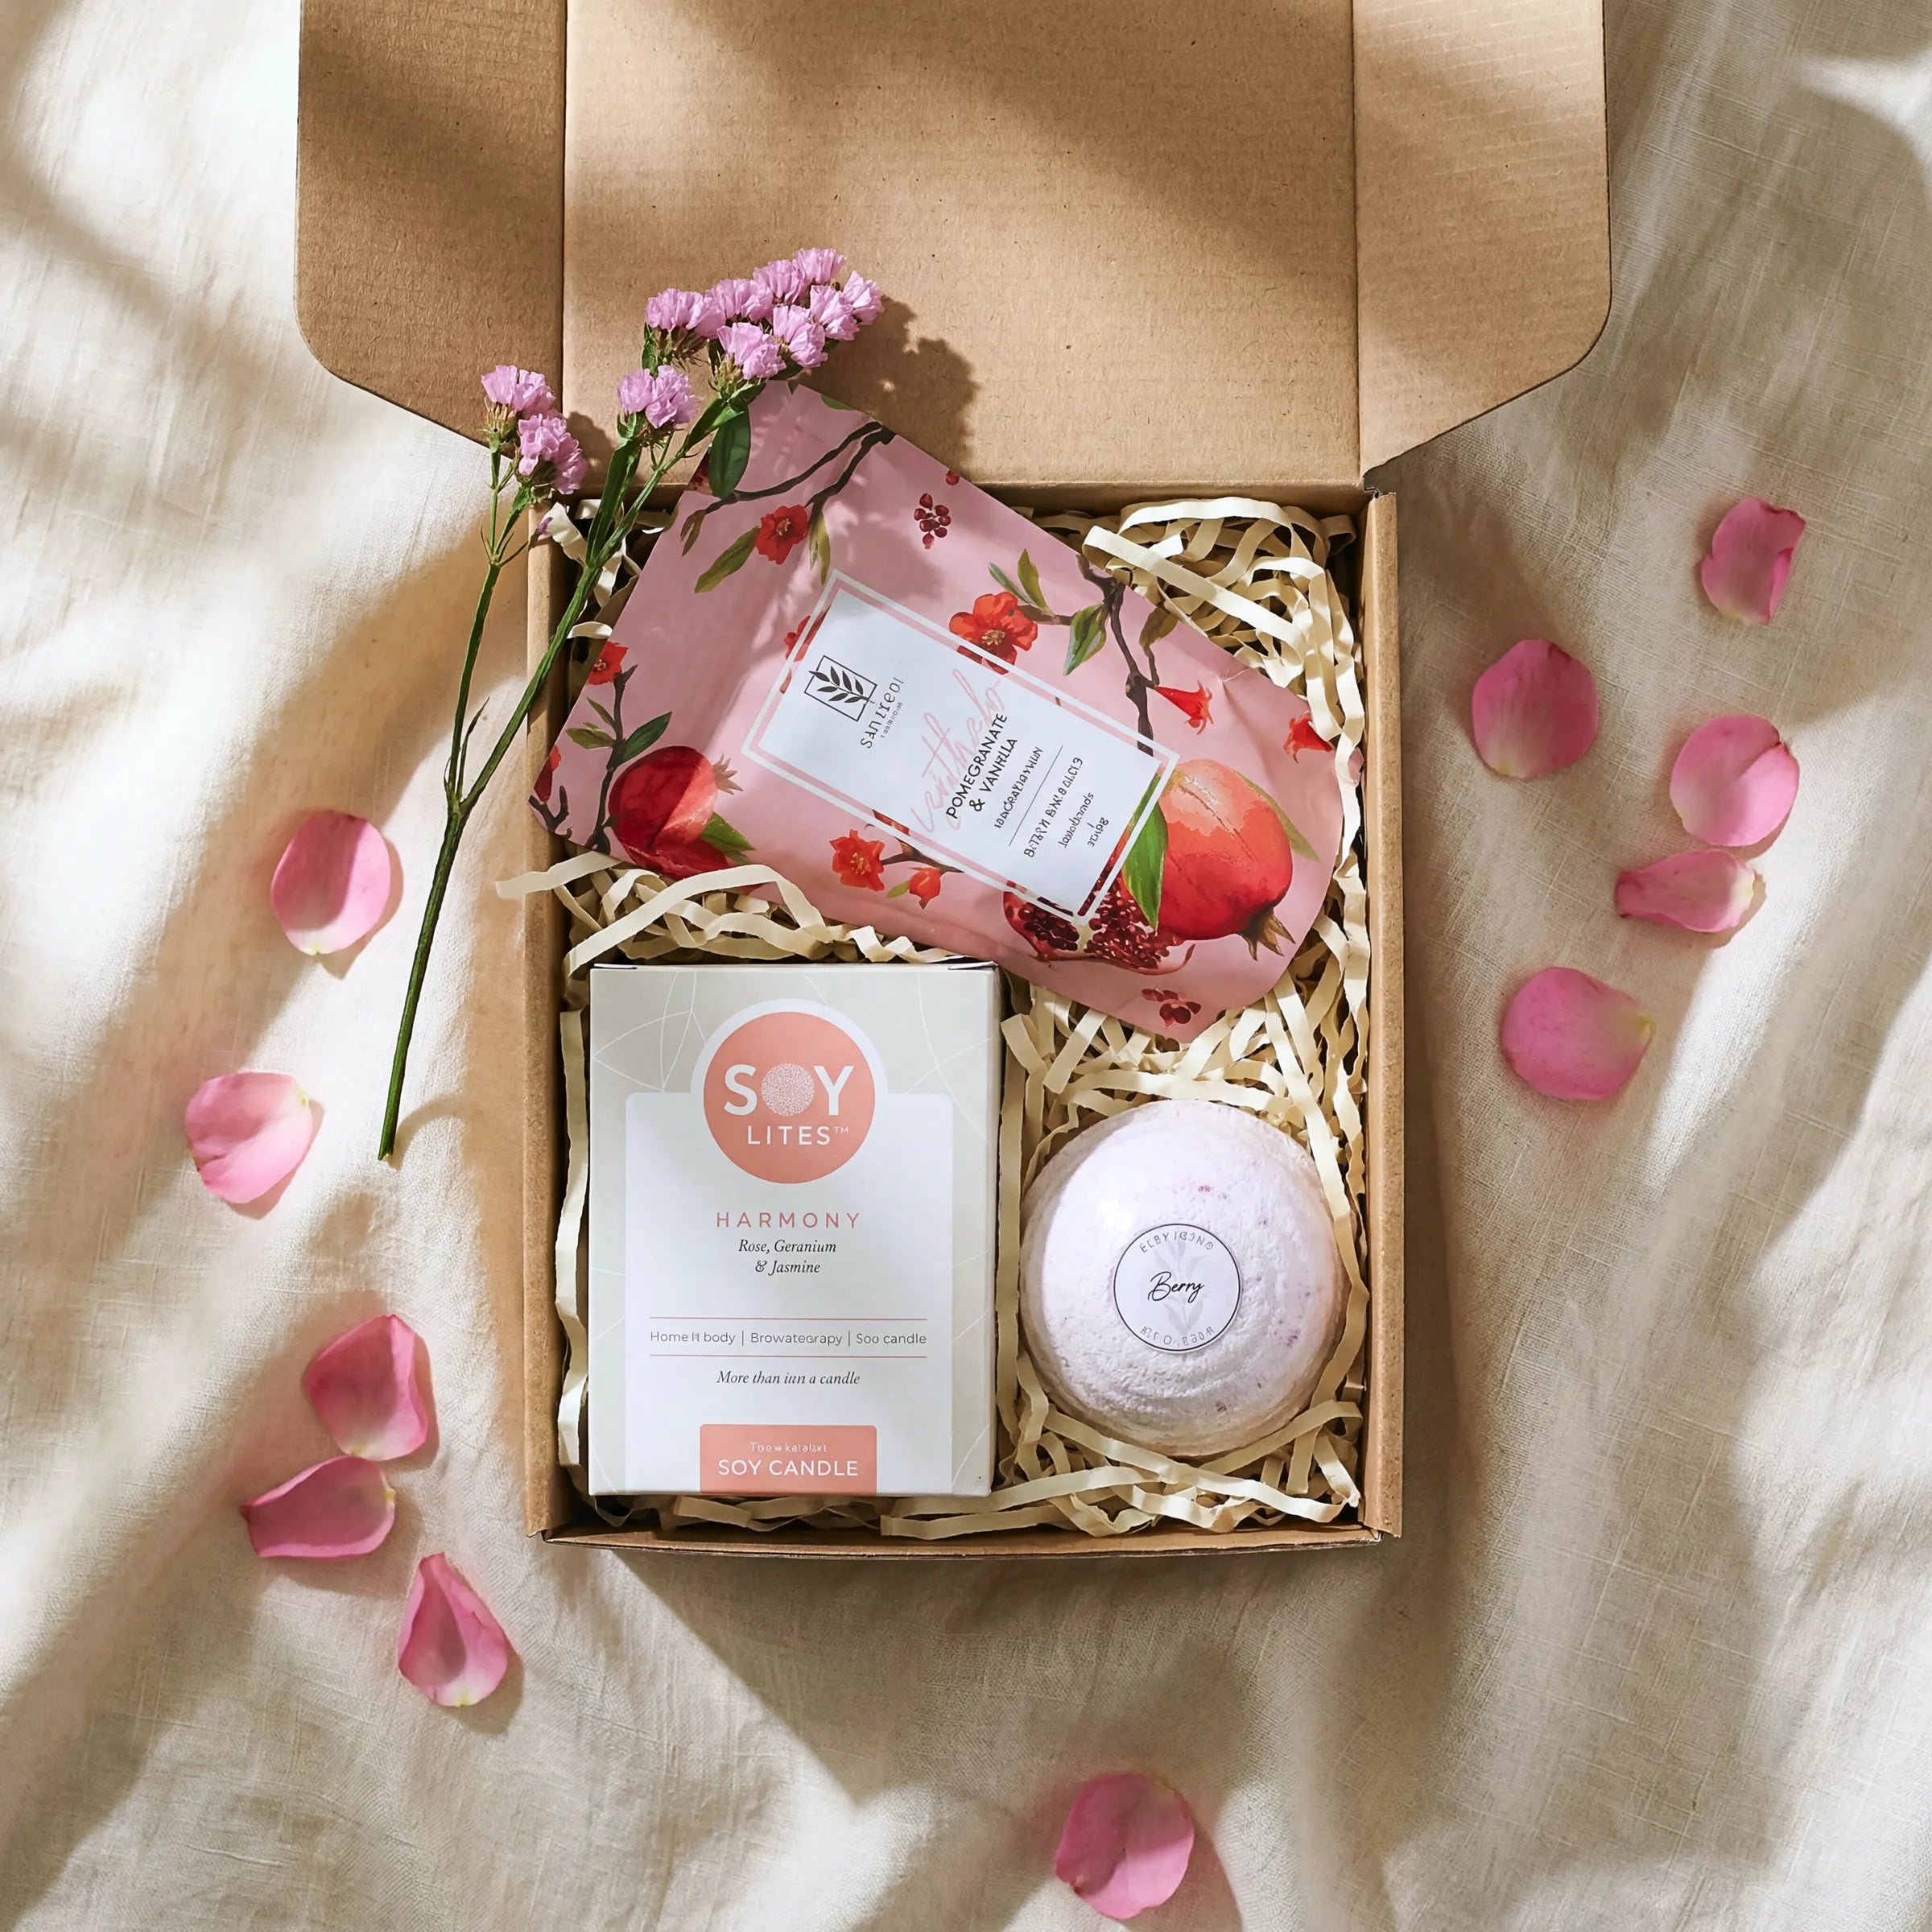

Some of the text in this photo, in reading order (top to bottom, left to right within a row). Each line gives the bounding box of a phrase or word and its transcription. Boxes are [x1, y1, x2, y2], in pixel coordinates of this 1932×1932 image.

[945, 712, 1009, 819] POMEGRANATE
[968, 798, 986, 812] &
[724, 1063, 855, 1117] SOY
[716, 1212, 859, 1228] HARMONY
[738, 1239, 837, 1254] Rose, Geranium
[754, 1259, 821, 1276] & Jasmine
[1147, 1271, 1205, 1304] Berry
[650, 1331, 688, 1342] Home
[704, 1331, 736, 1345] body
[883, 1333, 927, 1344] candle
[716, 1371, 749, 1384] More
[752, 1371, 781, 1385] than
[808, 1376, 816, 1385] a
[819, 1371, 861, 1385] candle
[718, 1459, 858, 1476] SOY CANDLE
